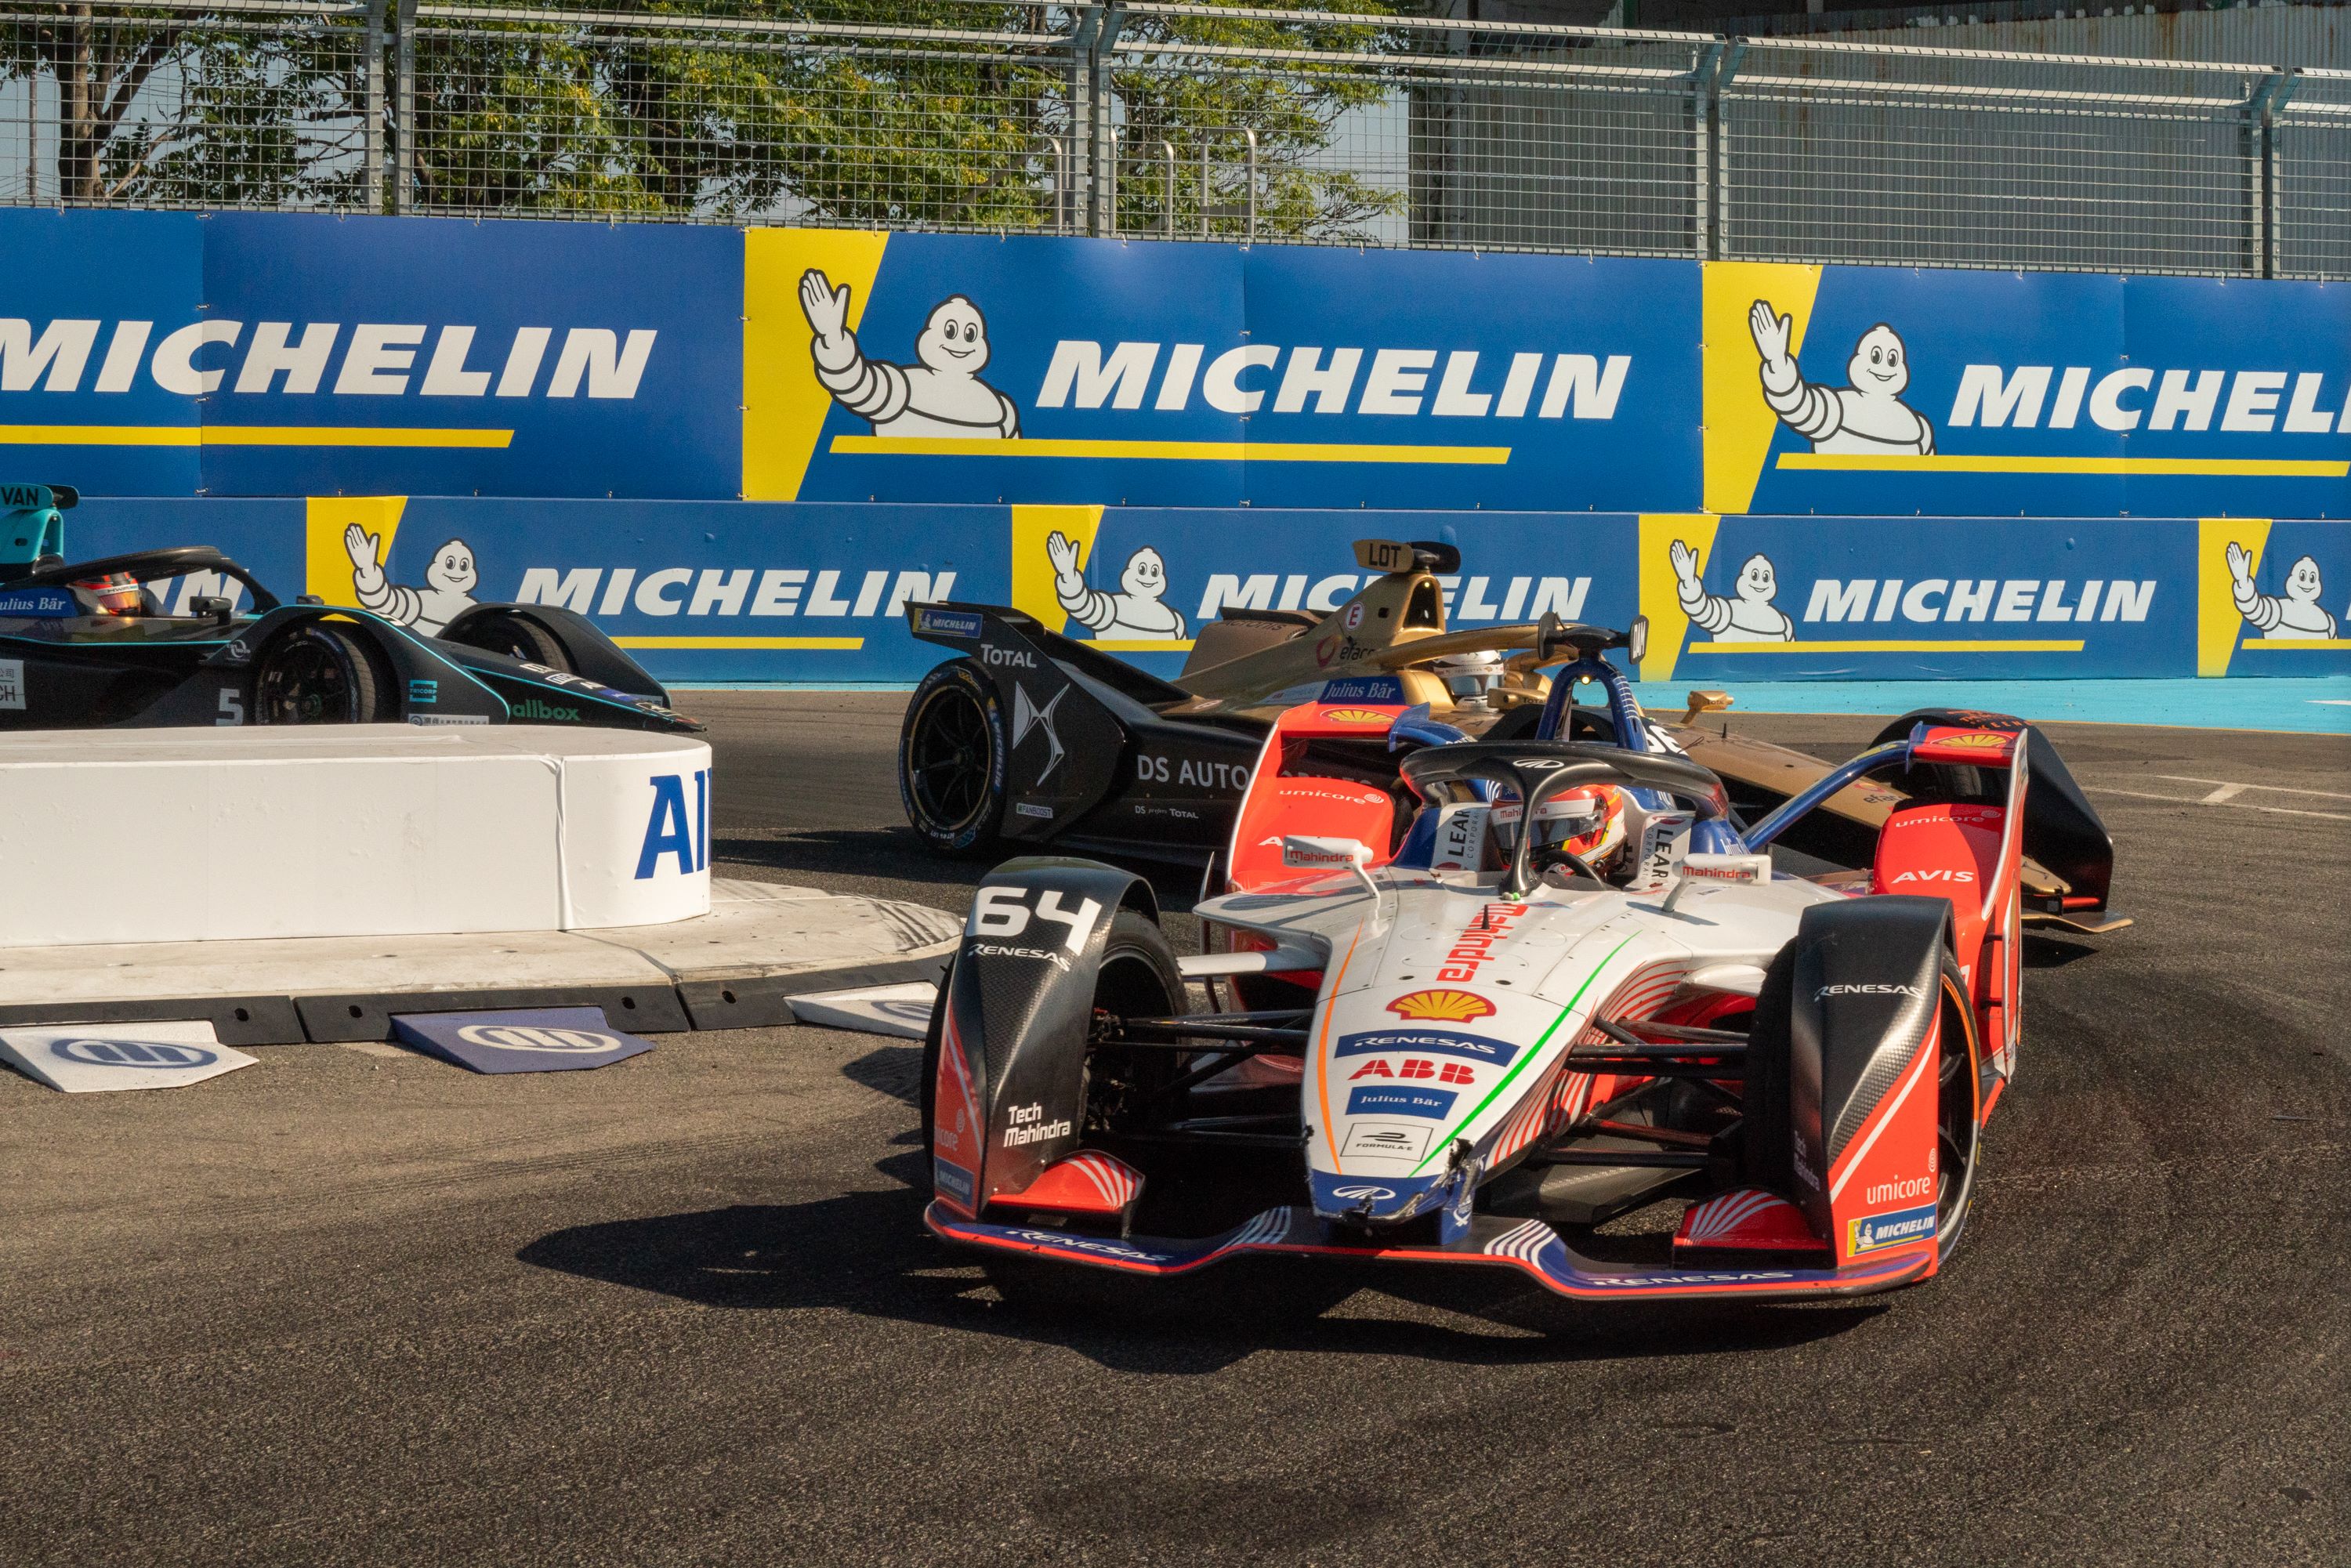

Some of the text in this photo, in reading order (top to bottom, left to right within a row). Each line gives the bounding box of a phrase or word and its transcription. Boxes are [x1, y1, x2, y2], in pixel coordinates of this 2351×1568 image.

[0, 319, 657, 398] MICHELIN
[1036, 340, 1631, 419] MICHELIN
[1, 487, 38, 506] VAN
[1368, 541, 1401, 567] LOT
[38, 597, 65, 610] Bär
[516, 568, 956, 617] MICHELIN
[1804, 579, 2157, 622] MICHELIN
[932, 617, 976, 631] MICHELIN
[981, 644, 1037, 668] TOTAL
[1325, 683, 1365, 699] Julius
[1367, 683, 1396, 699] Bär
[216, 688, 244, 726] 5
[1138, 755, 1169, 783] DS
[1279, 790, 1366, 806] umicore
[1135, 805, 1147, 815] DS
[1168, 807, 1199, 820] TOTAL
[1500, 806, 1548, 820] Mahira
[1895, 814, 1985, 829] umicore
[1447, 810, 1471, 857] LEAR
[1467, 812, 1480, 859] CORPORA
[1290, 849, 1354, 863] Mahindra
[1651, 829, 1674, 879] LEAR
[1682, 865, 1751, 878] Mahindra
[1892, 869, 1974, 884] AVIS
[965, 885, 1102, 956] 64
[1436, 904, 1529, 983] Mahindra
[968, 943, 1070, 972] RENESAS
[1814, 984, 1925, 1003] RENESAS
[1354, 1036, 1496, 1055] RENESAS
[1347, 1059, 1475, 1085] ABB
[1009, 1102, 1041, 1125] Tech
[1360, 1095, 1443, 1107] Julius Bär
[1004, 1119, 1071, 1148] Mahindra
[1867, 1175, 1931, 1205] umicore
[1875, 1215, 1935, 1240] MICHELIN
[1006, 1228, 1174, 1262] RENESAS
[1588, 1271, 1794, 1286] RENESAS
